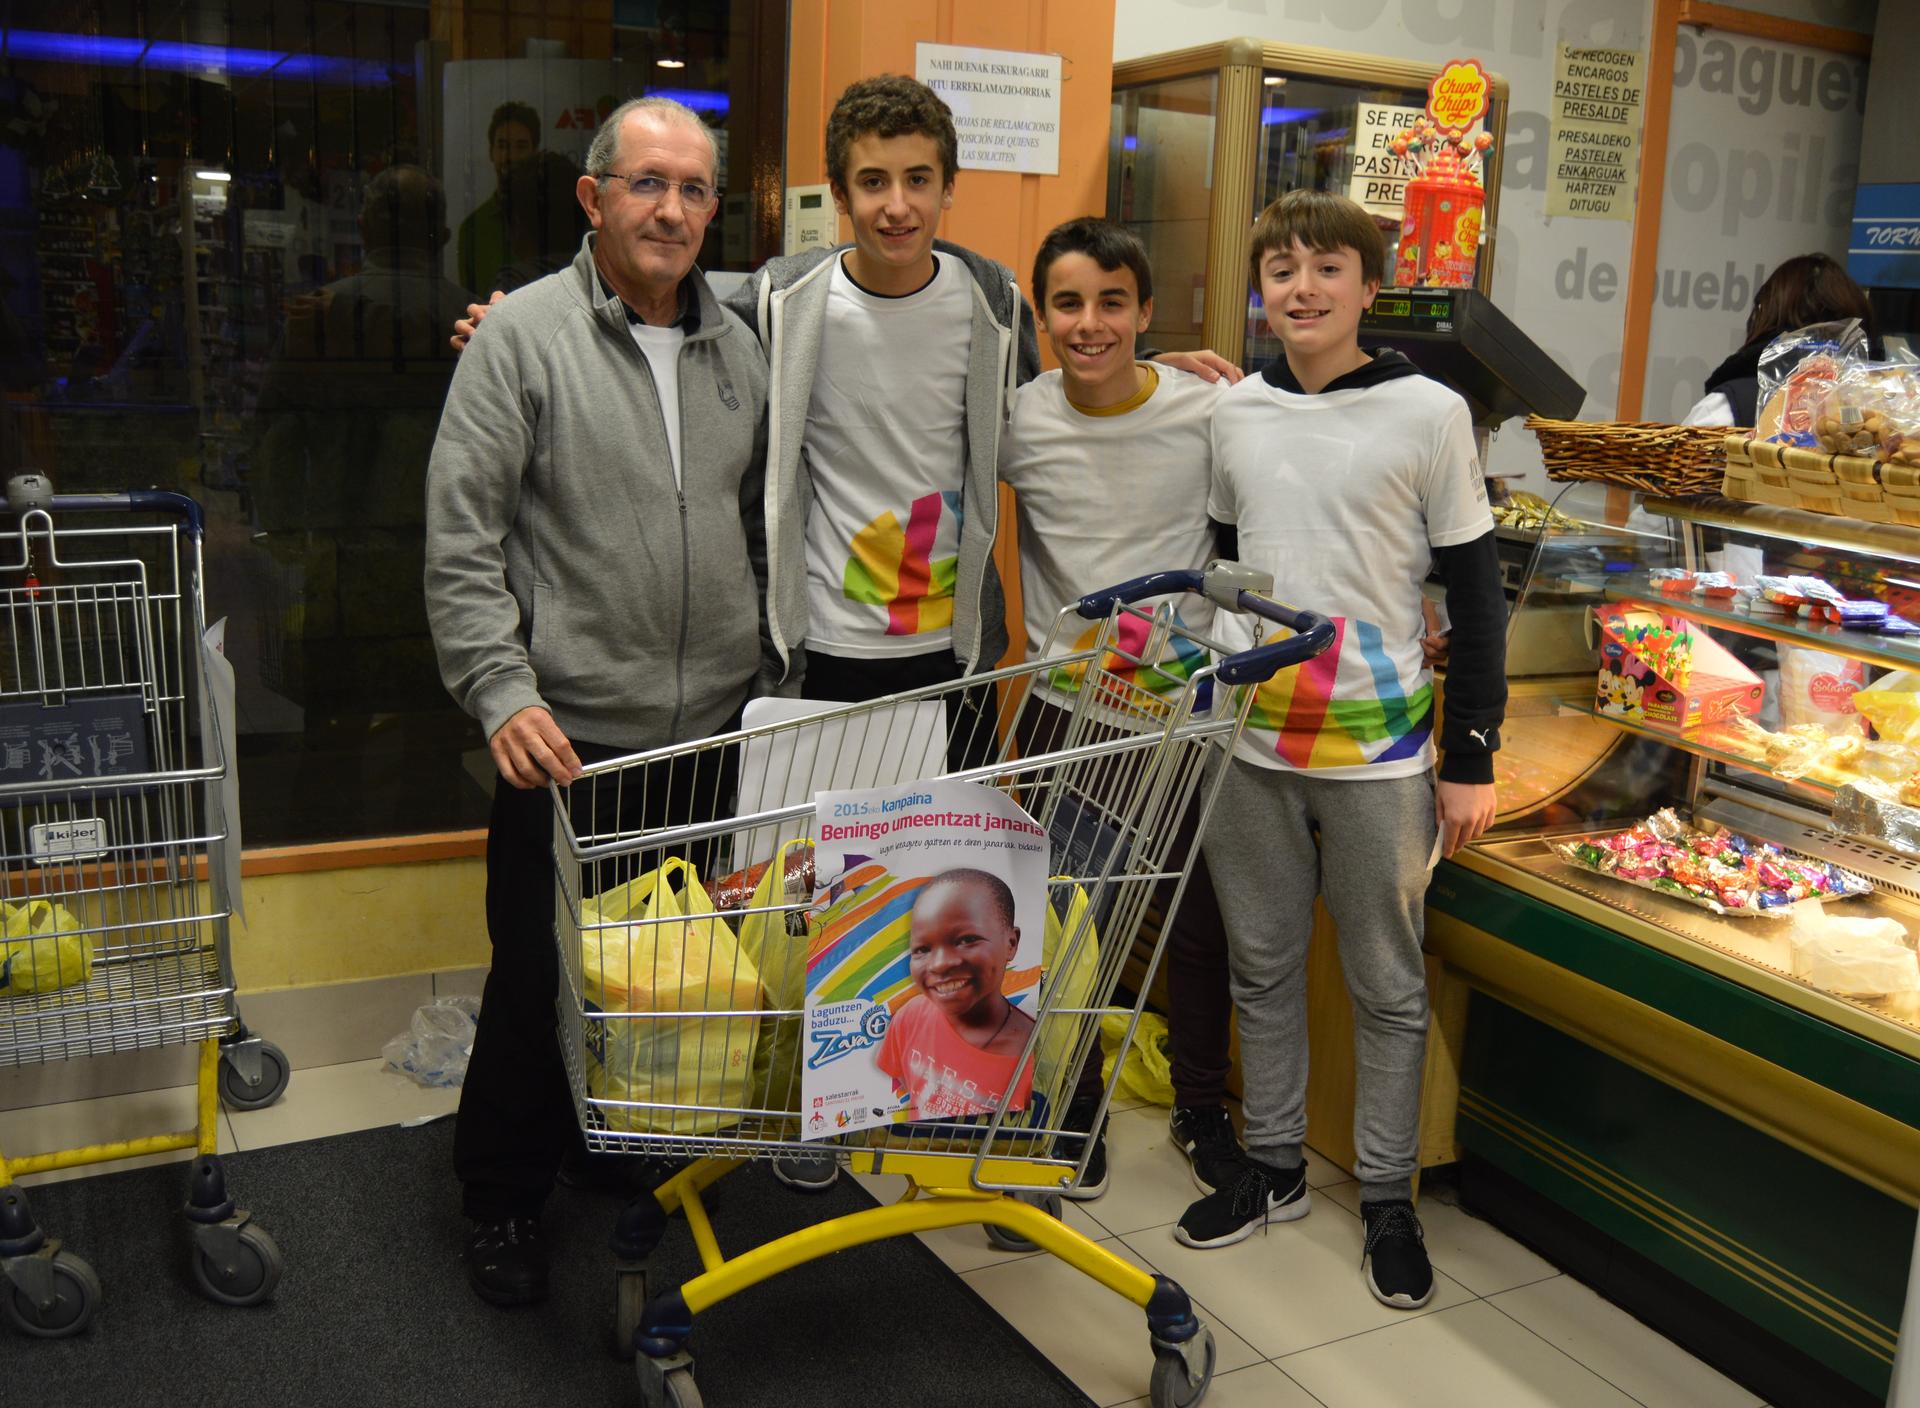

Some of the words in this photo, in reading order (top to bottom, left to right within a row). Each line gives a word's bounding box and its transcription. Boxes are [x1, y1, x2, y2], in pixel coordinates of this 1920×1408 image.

[1581, 50, 1635, 67] RECOGEN
[930, 58, 952, 71] NAHI
[954, 60, 989, 74] DUENAK
[991, 64, 1049, 79] ESKURAGARRI
[1567, 64, 1629, 83] ENCARGOS
[928, 78, 947, 90] DITU
[950, 80, 1051, 98] ERREKLAMAZIO-ORRIAK
[1439, 78, 1482, 97] Chupa
[1555, 80, 1619, 101] PASTELES
[1622, 88, 1640, 103] DE
[1433, 95, 1477, 114] Chups
[1563, 101, 1629, 121] PRESALDE
[954, 116, 979, 128] HOJAS
[980, 118, 992, 129] DE
[993, 119, 1055, 133] RECLAMACIONES
[1366, 110, 1388, 126] SE
[957, 132, 993, 145] POSICIÓN
[994, 134, 1005, 145] DE
[1006, 135, 1040, 148] QUIENES
[1557, 129, 1631, 148] PRESALDEKO
[961, 150, 976, 161] LAS
[977, 151, 1017, 163] SOLICITEN
[1565, 147, 1622, 164] PASTELEN
[1557, 163, 1627, 182] ENKARGUAK
[1365, 182, 1403, 201] PRE
[1565, 181, 1616, 197] HARTZEN
[1569, 198, 1610, 213] DITUGU
[1554, 246, 1618, 303] de
[881, 792, 932, 814] kanpaina
[56, 829, 96, 839] kider
[820, 819, 889, 842] Beningo
[891, 811, 982, 832] umeentzat
[983, 812, 1045, 837] janaria
[982, 839, 1016, 850] janariak
[811, 1003, 862, 1018] Laguntzen
[811, 1016, 855, 1029] baduzu...
